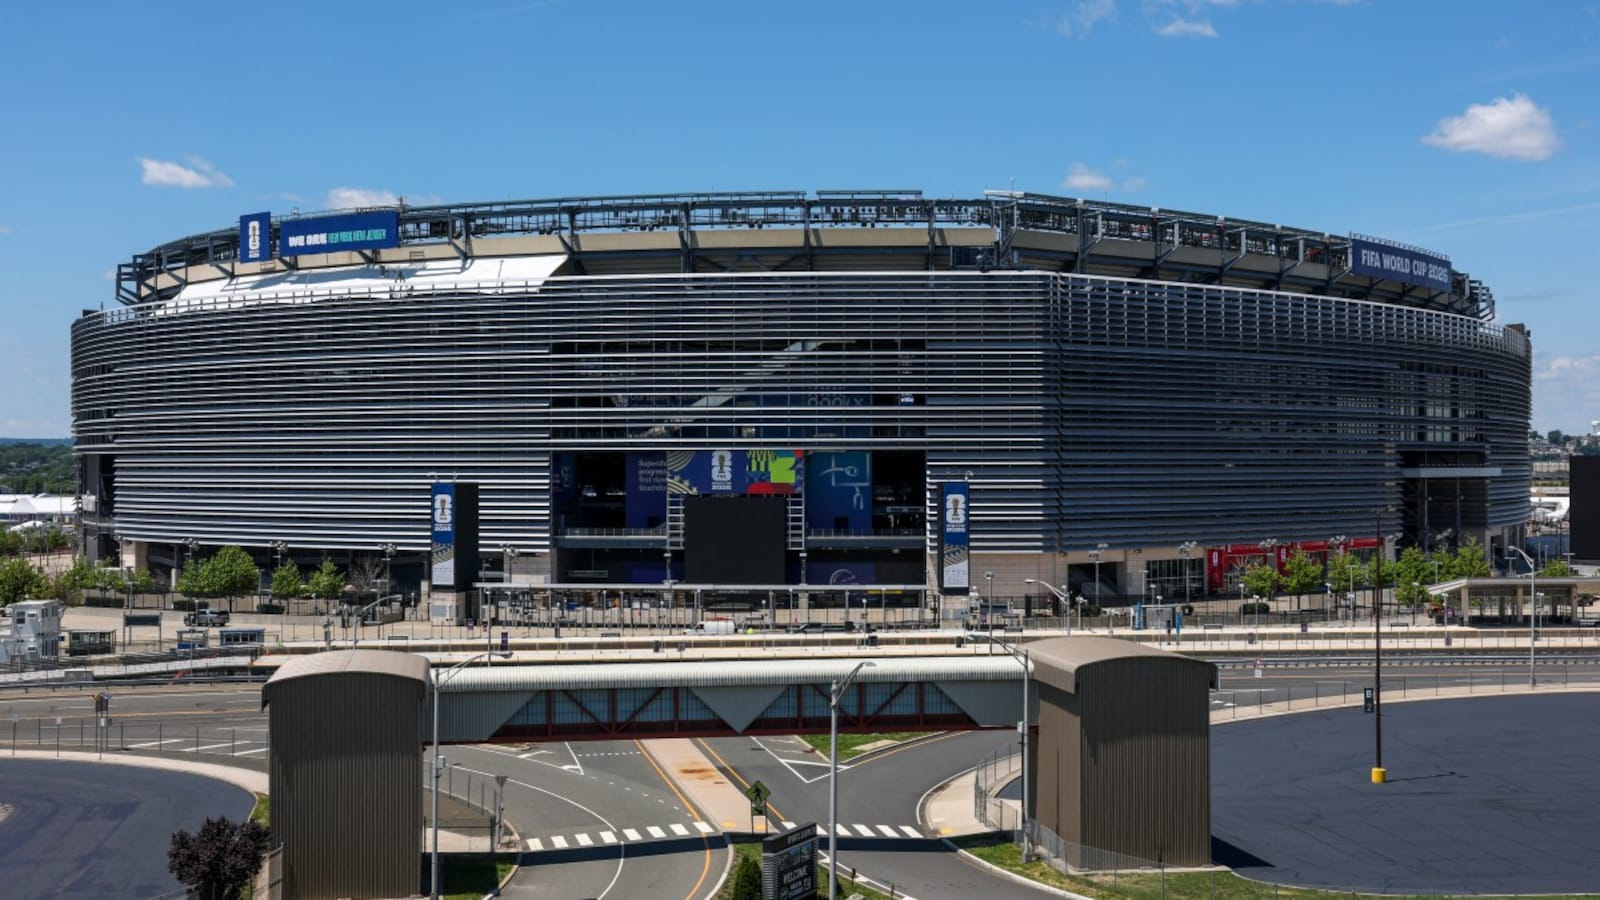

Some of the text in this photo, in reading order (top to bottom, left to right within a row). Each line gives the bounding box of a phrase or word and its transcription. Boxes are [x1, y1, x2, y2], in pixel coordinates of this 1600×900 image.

[289, 235, 304, 247] WE
[1361, 249, 1449, 283] FIFA WORLD CUP 2026
[1366, 690, 1371, 698] B
